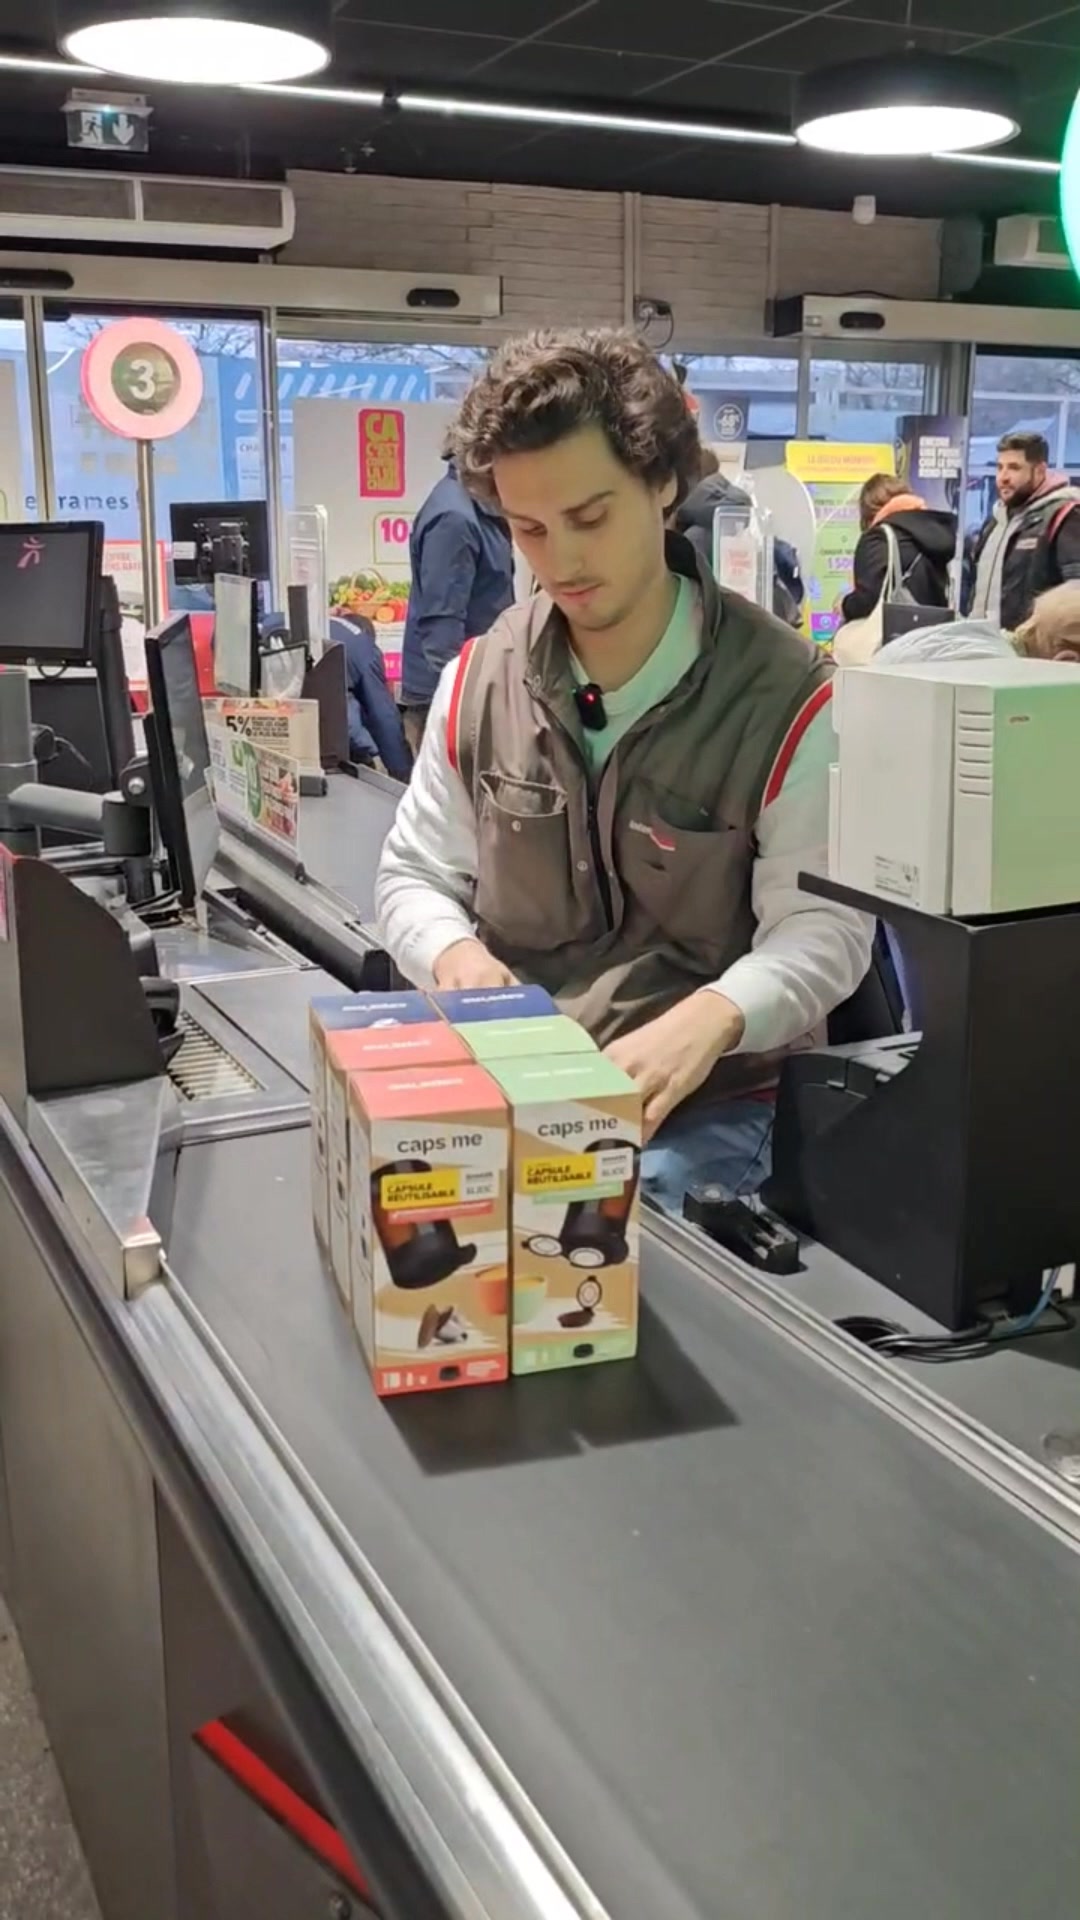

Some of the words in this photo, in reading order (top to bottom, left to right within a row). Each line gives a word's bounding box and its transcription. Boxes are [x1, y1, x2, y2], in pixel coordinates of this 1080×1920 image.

[129, 359, 156, 400] 3
[537, 1119, 584, 1138] caps
[589, 1117, 618, 1131] me
[396, 1137, 446, 1155] caps
[452, 1132, 483, 1148] me
